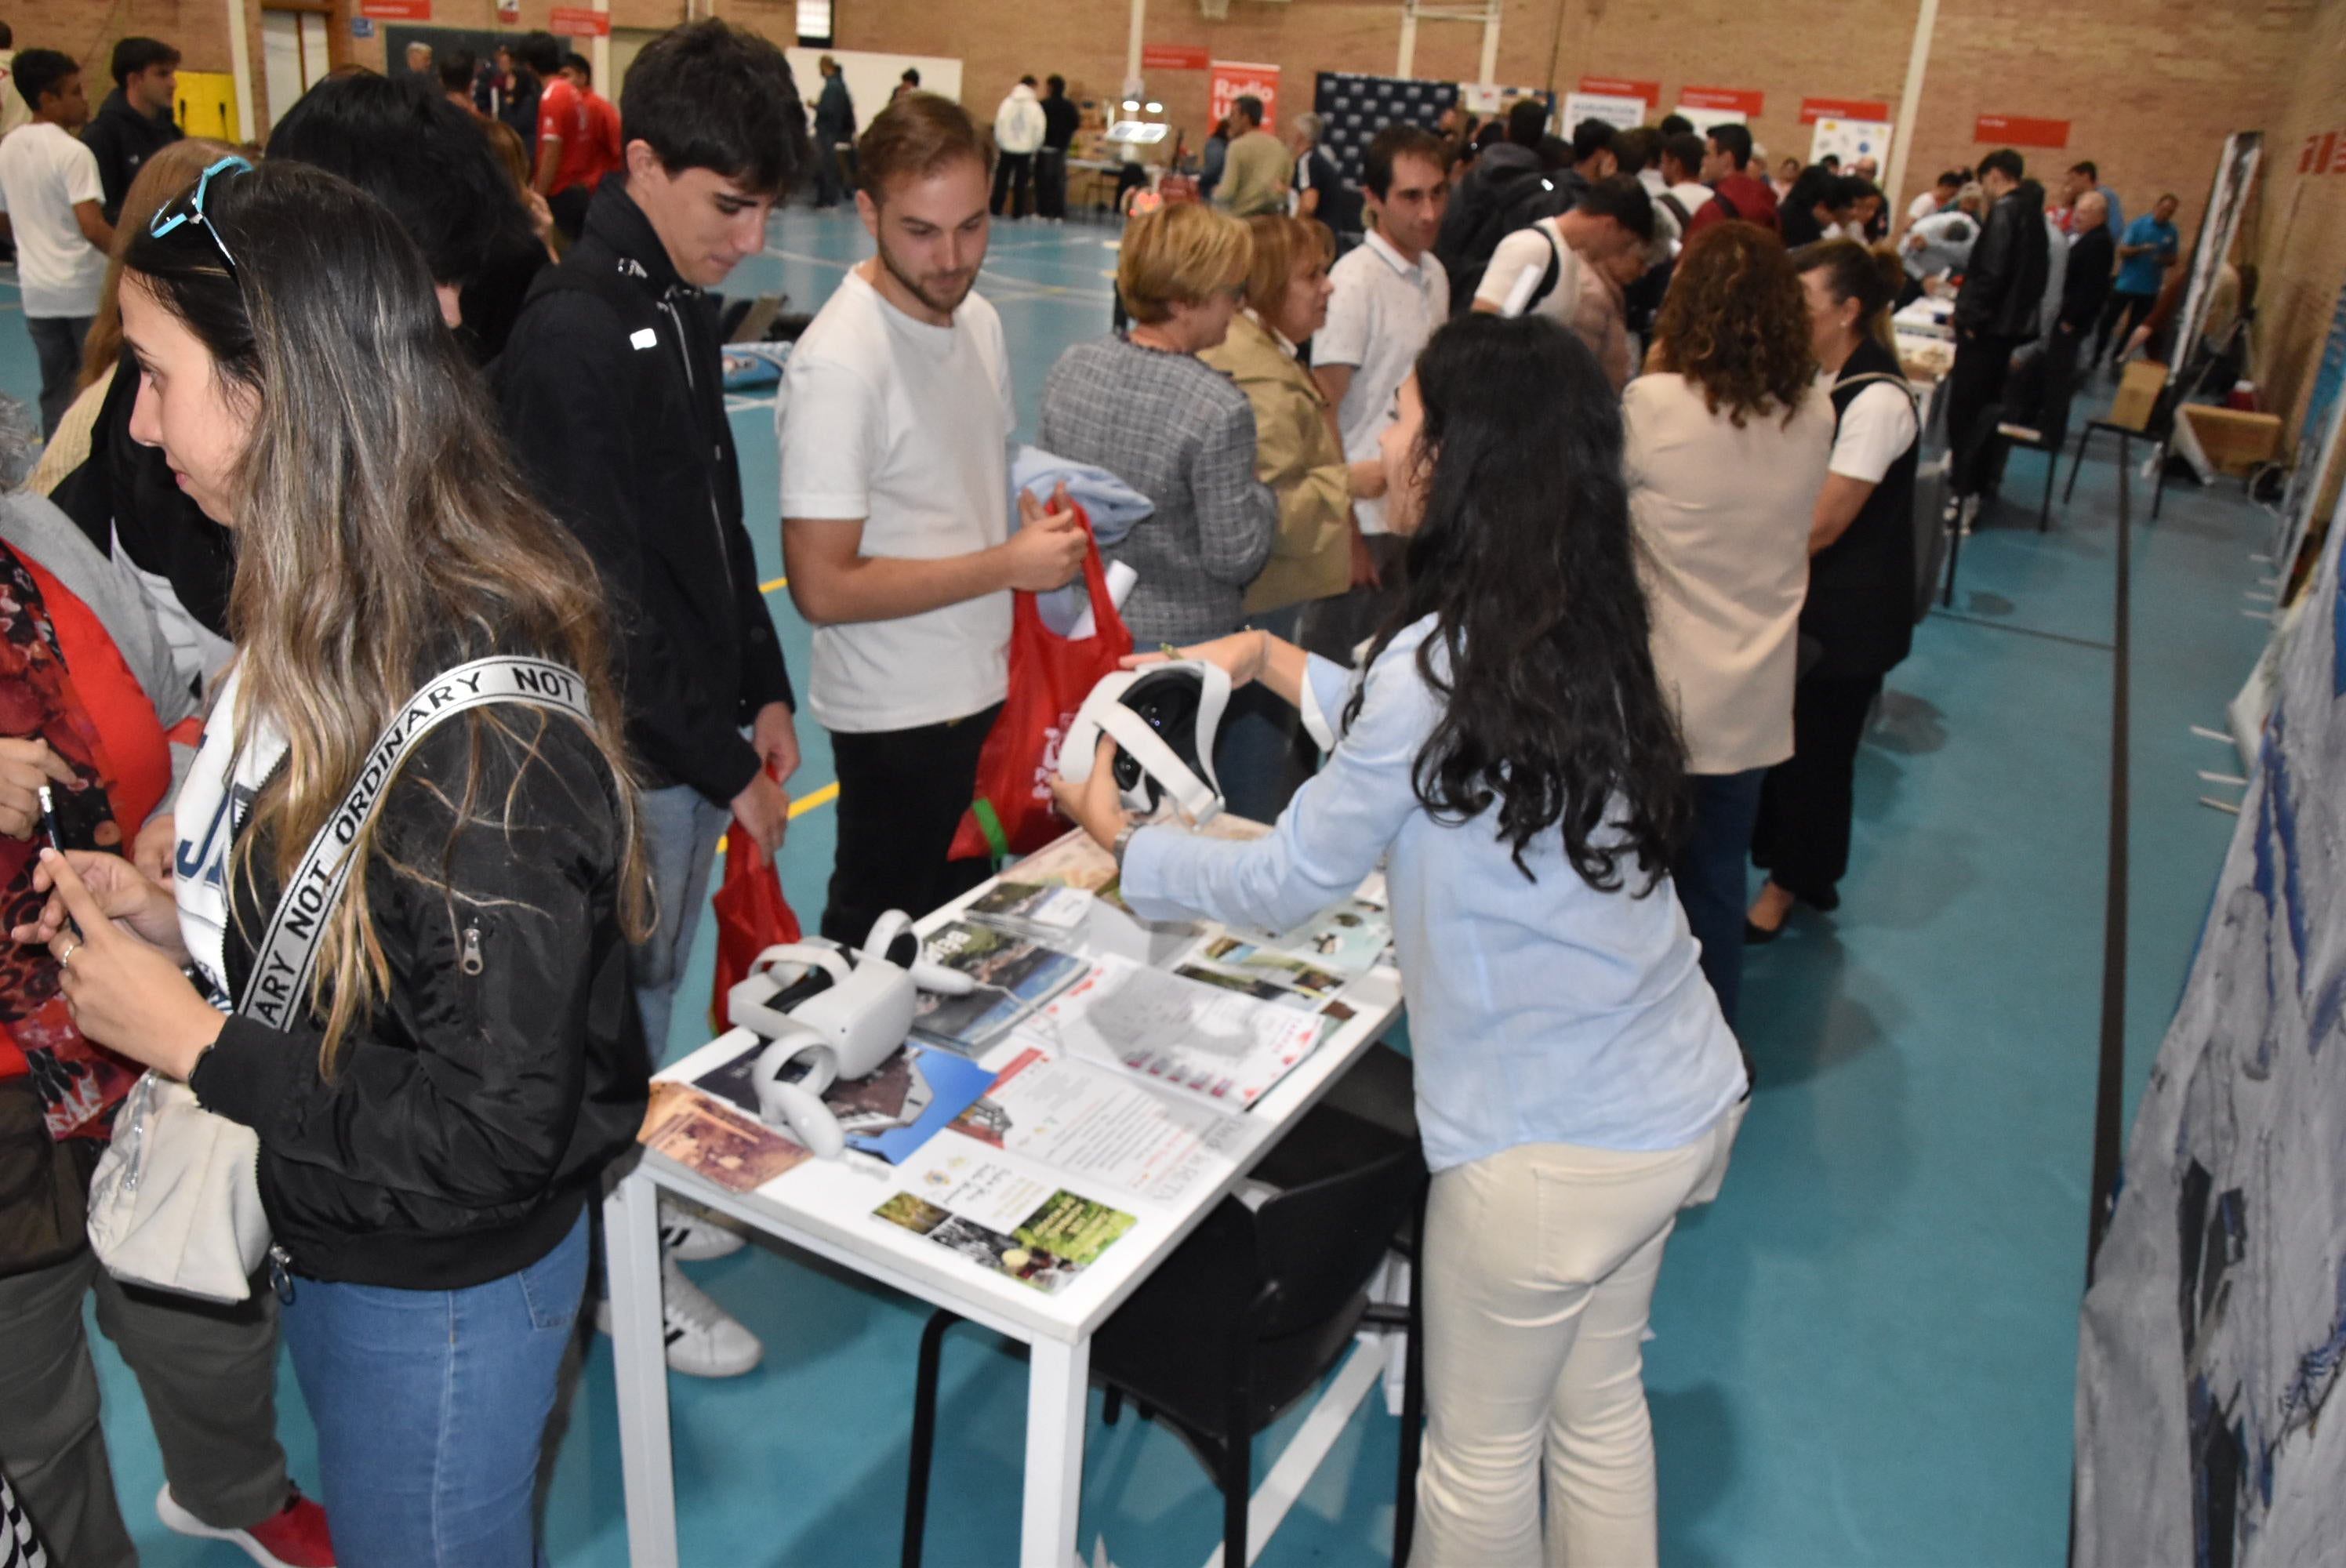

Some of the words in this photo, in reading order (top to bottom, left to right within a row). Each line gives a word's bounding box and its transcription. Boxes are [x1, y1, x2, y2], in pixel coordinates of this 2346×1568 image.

[285, 859, 332, 941] NOT
[335, 671, 481, 845] ORDINARY
[512, 666, 573, 702] NOT
